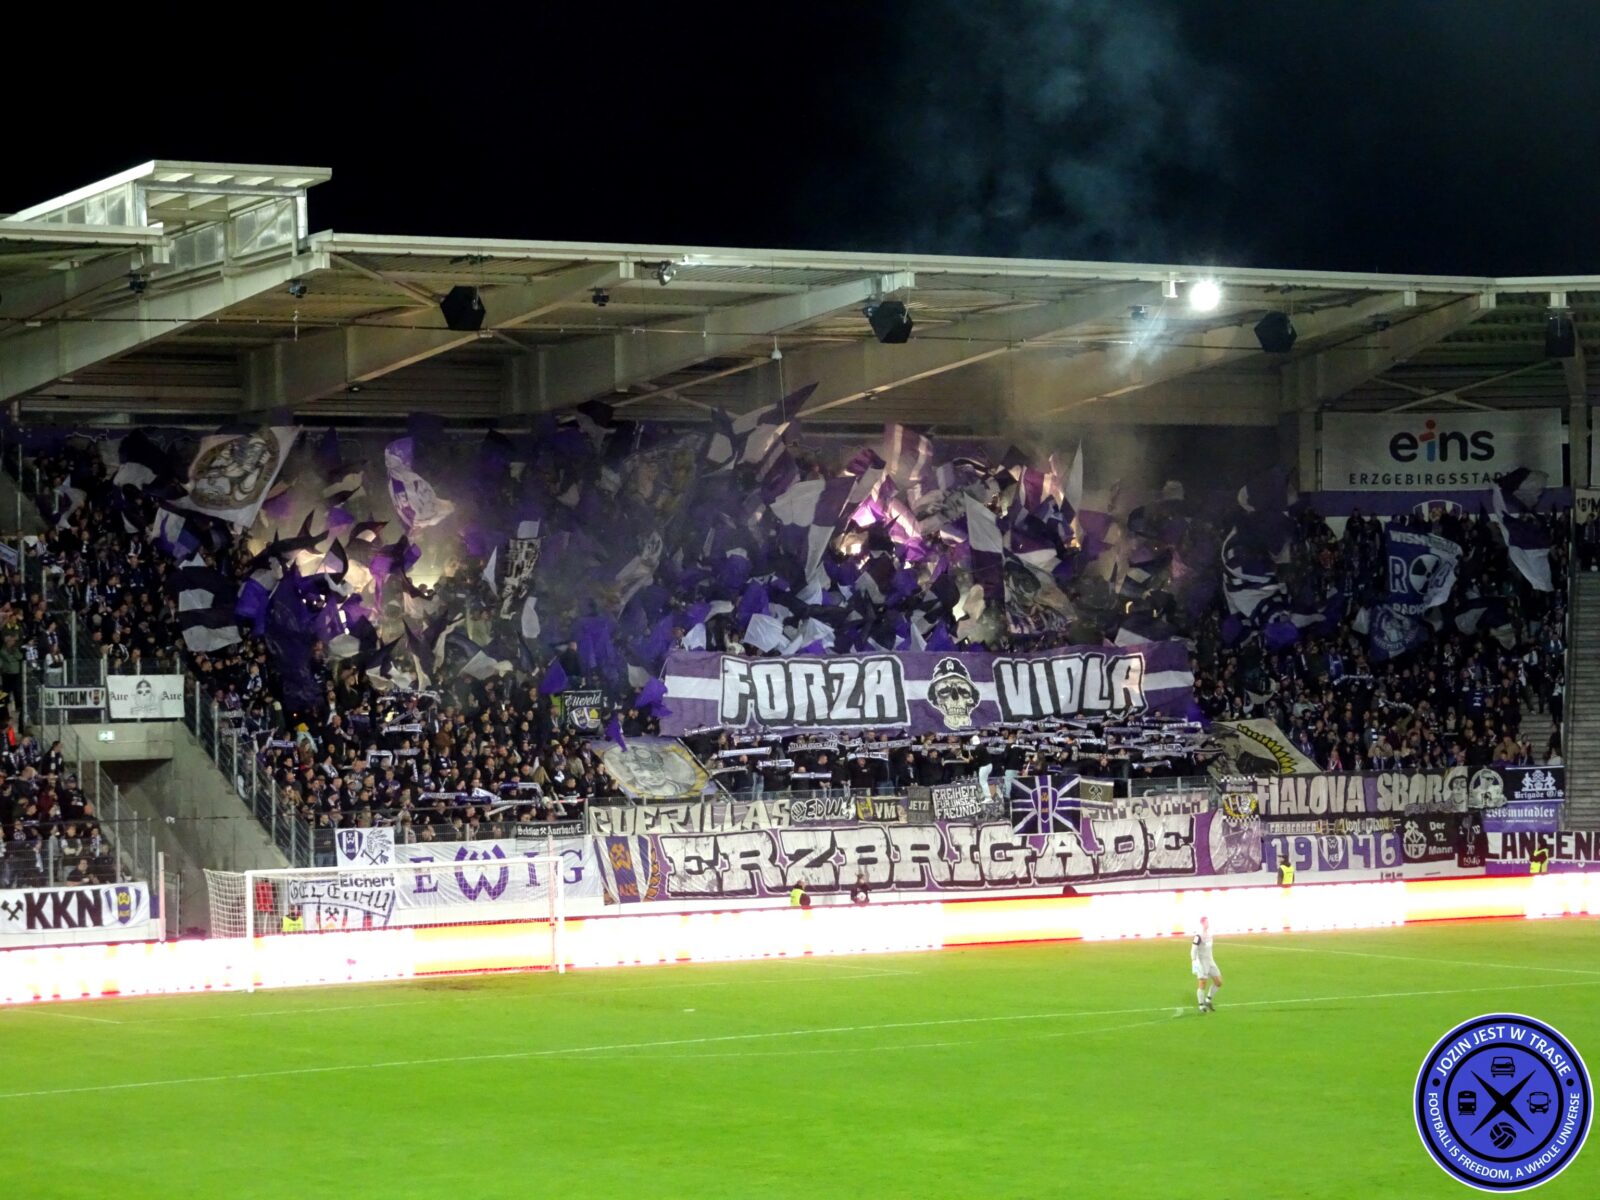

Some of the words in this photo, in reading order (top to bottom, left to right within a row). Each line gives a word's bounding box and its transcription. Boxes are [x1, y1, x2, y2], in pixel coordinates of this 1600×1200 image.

[1389, 419, 1495, 463] eins
[1349, 472, 1511, 486] ERZGEBIRGSSTAD
[58, 691, 88, 706] THOLM
[721, 656, 908, 727] FORZA
[994, 655, 1146, 722] VIOLA
[908, 800, 930, 811] JETZT
[934, 785, 977, 800] FREIHEIT
[1256, 775, 1367, 815] FIALOVA
[589, 798, 791, 836] GUERILLAS
[937, 803, 982, 819] FREUNDE
[1429, 821, 1446, 831] Der
[660, 814, 1196, 894] ERZBRIGADE
[1428, 845, 1453, 856] Mann
[409, 845, 585, 900] EWIG
[24, 888, 103, 930] KKN
